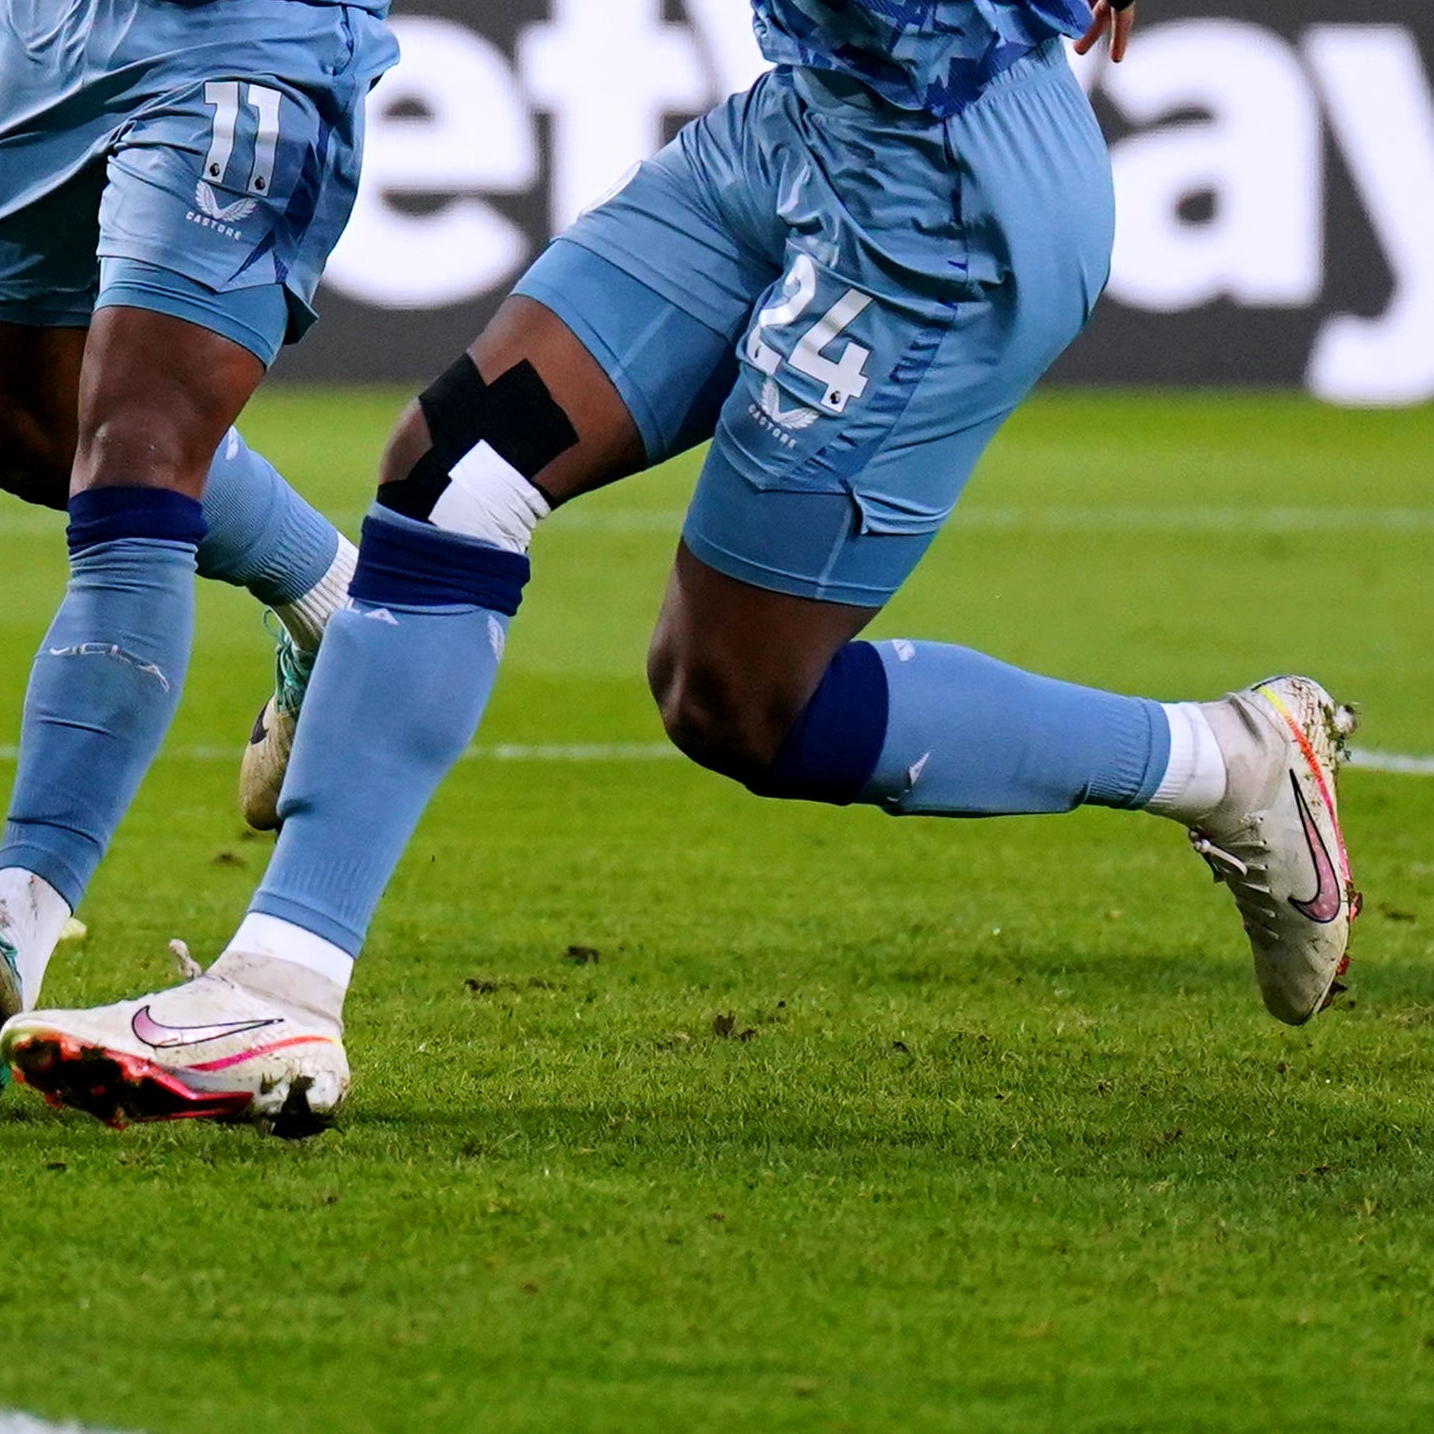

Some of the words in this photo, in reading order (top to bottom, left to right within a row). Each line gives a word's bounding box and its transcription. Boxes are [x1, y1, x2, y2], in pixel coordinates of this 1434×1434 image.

[201, 80, 282, 198] 11
[185, 210, 243, 241] CASTORE
[745, 254, 874, 413] 24
[747, 403, 797, 449] CASTORE
